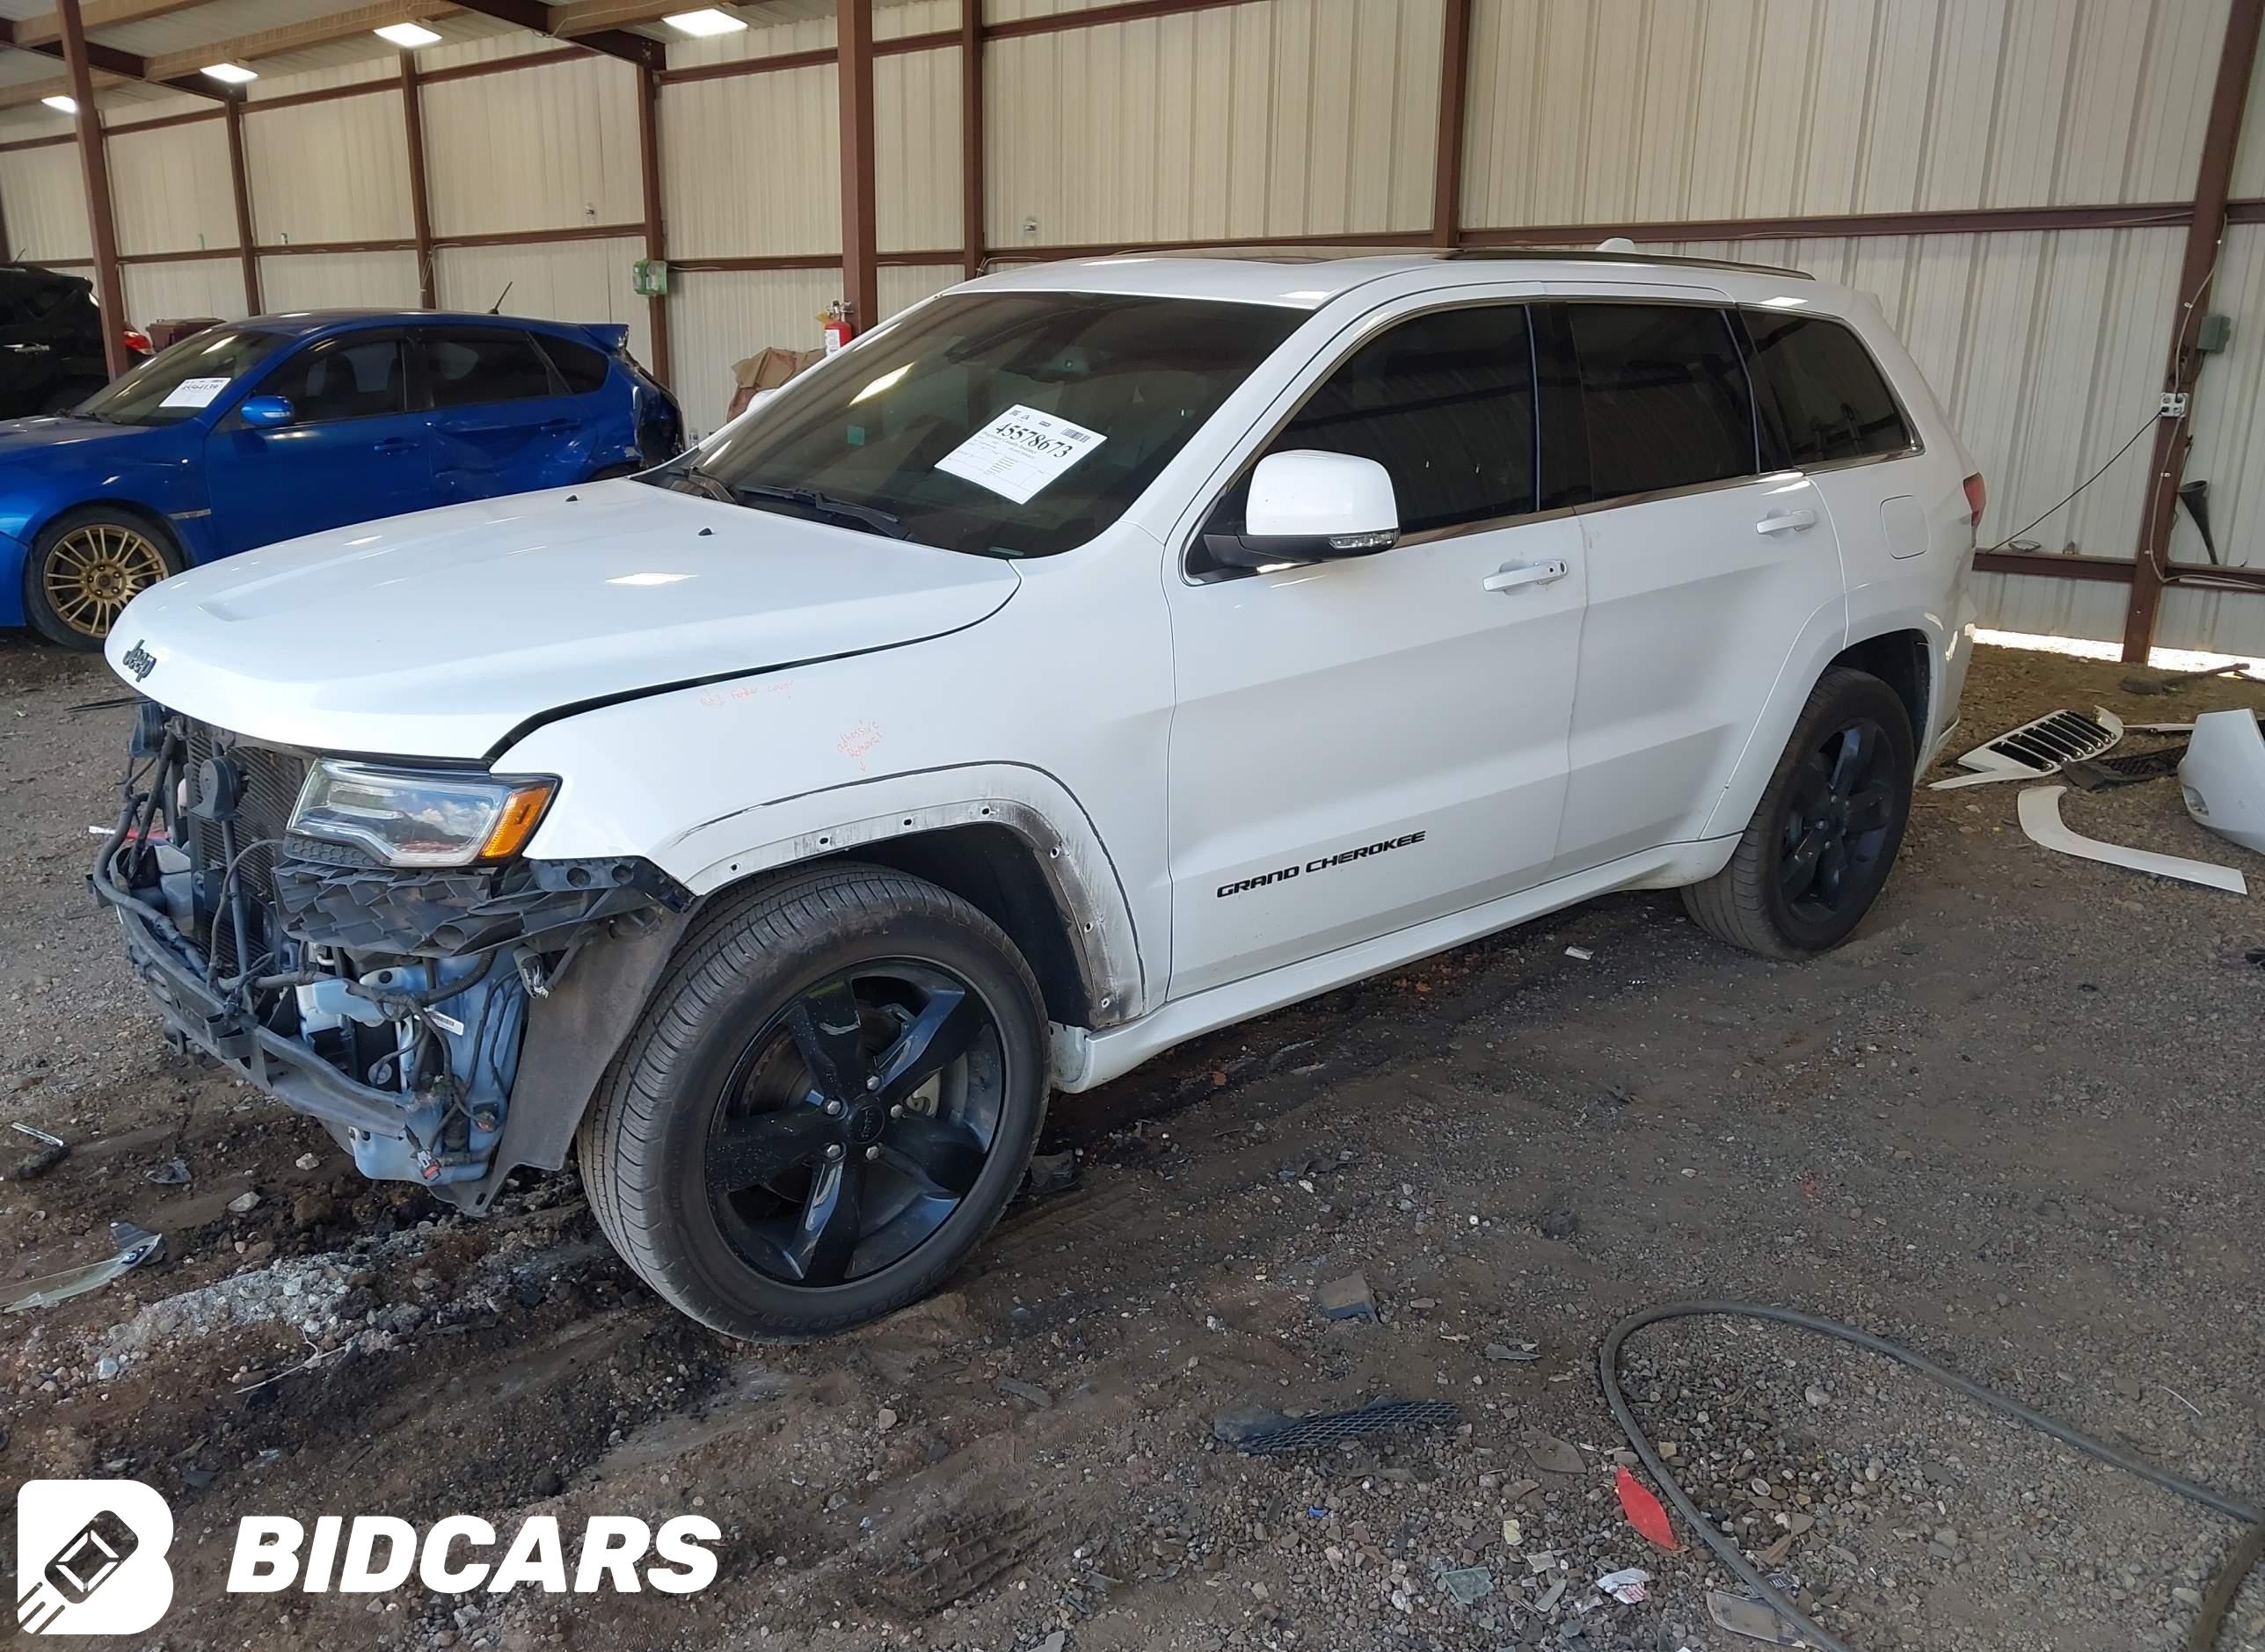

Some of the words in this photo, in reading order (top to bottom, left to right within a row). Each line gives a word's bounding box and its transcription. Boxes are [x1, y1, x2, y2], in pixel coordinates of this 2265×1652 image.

[996, 422, 1073, 458] 45578673
[122, 639, 157, 682] Jeep
[1217, 865, 1300, 898] GRAND
[1306, 831, 1426, 873] CHEROKEE
